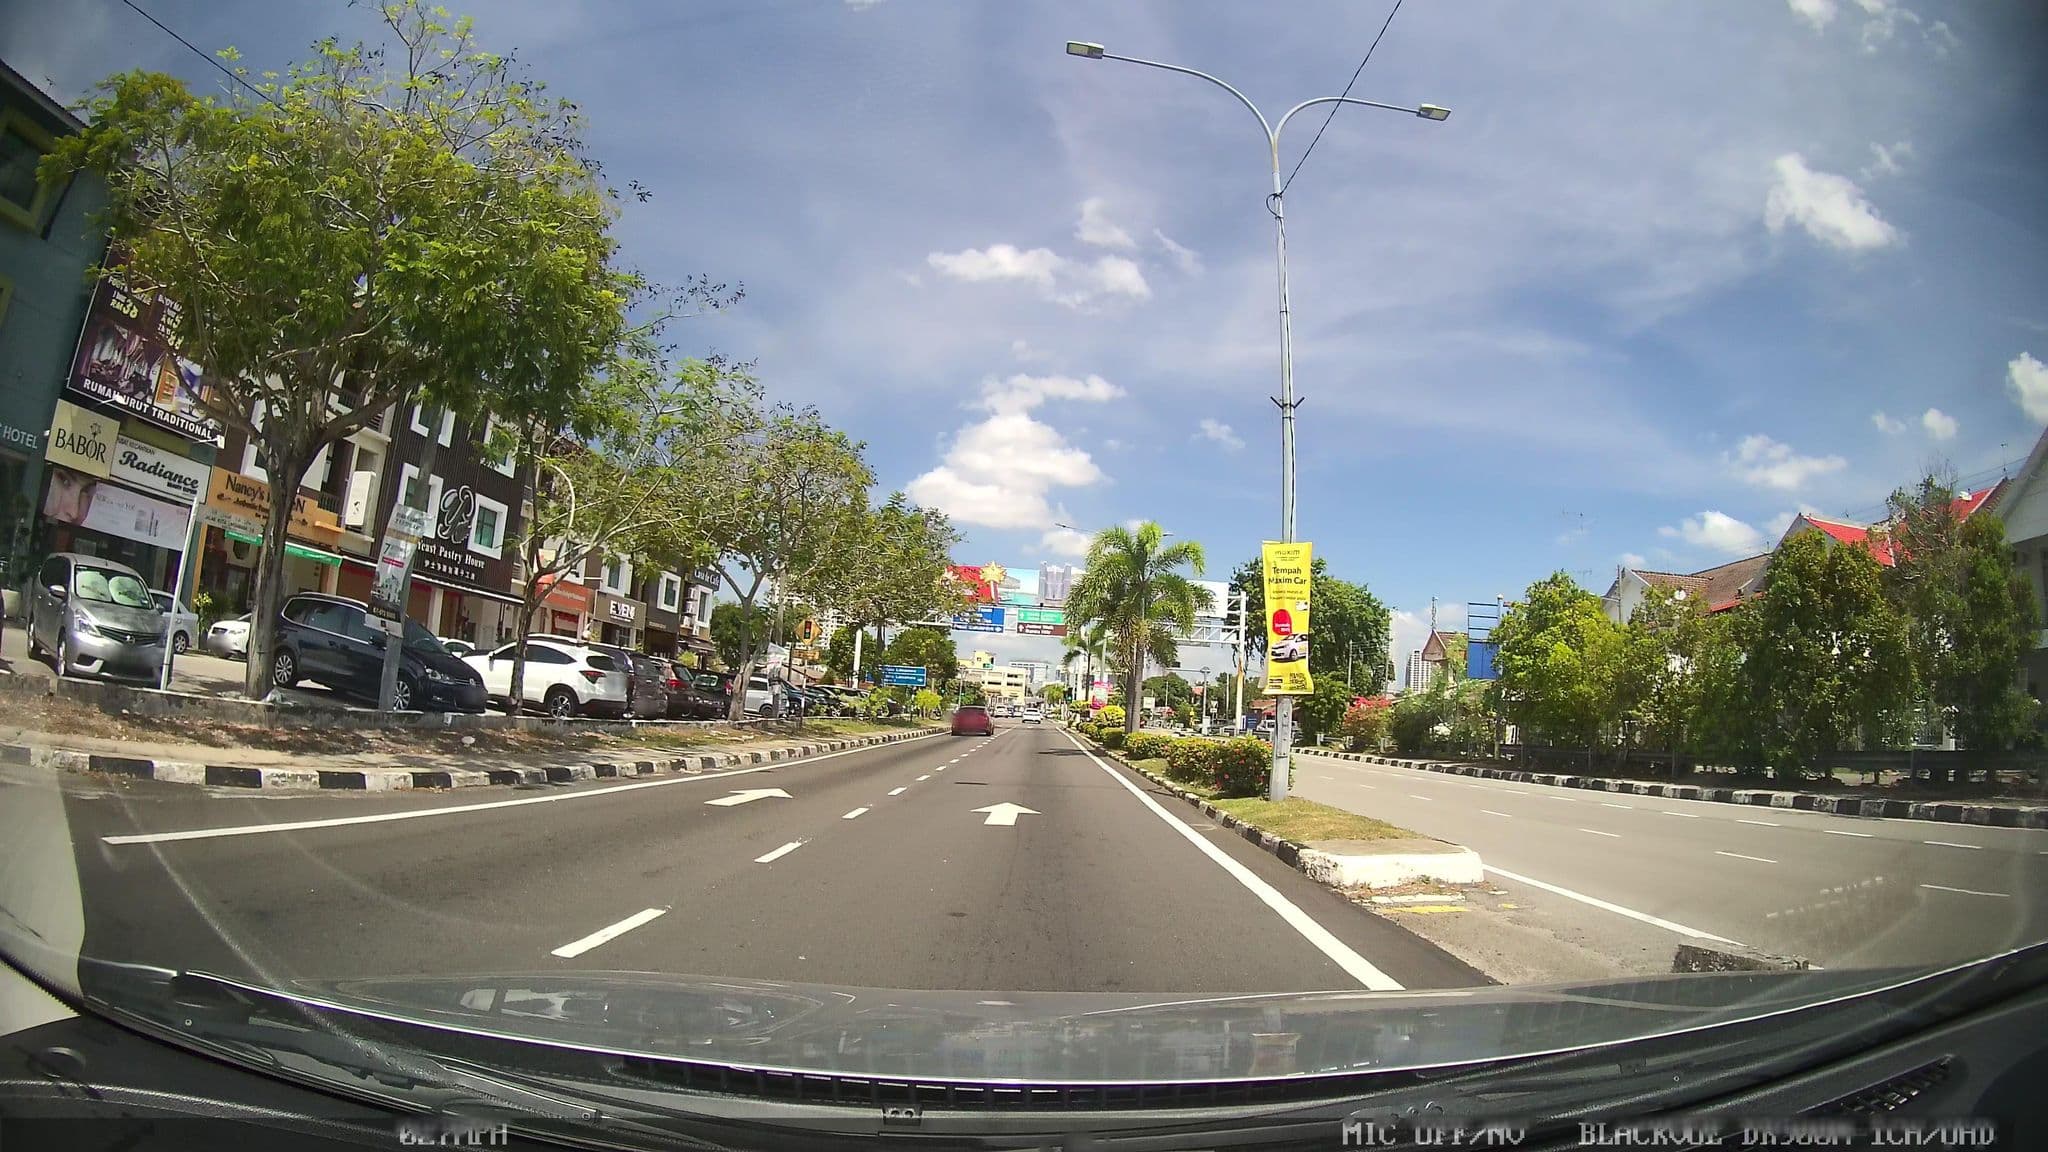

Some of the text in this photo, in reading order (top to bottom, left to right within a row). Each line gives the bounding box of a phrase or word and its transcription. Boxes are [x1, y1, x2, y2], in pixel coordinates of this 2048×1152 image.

[122, 394, 150, 413] URUT
[151, 406, 213, 440] TRADITIONAL
[3, 425, 38, 449] HOTEL
[55, 427, 107, 463] BABOR
[118, 450, 199, 489] Radiance
[225, 474, 265, 501] Nancy's
[417, 540, 485, 569] Yeast Pastry House
[1268, 576, 1307, 585] Maxim Car
[1272, 566, 1302, 575] Tempah
